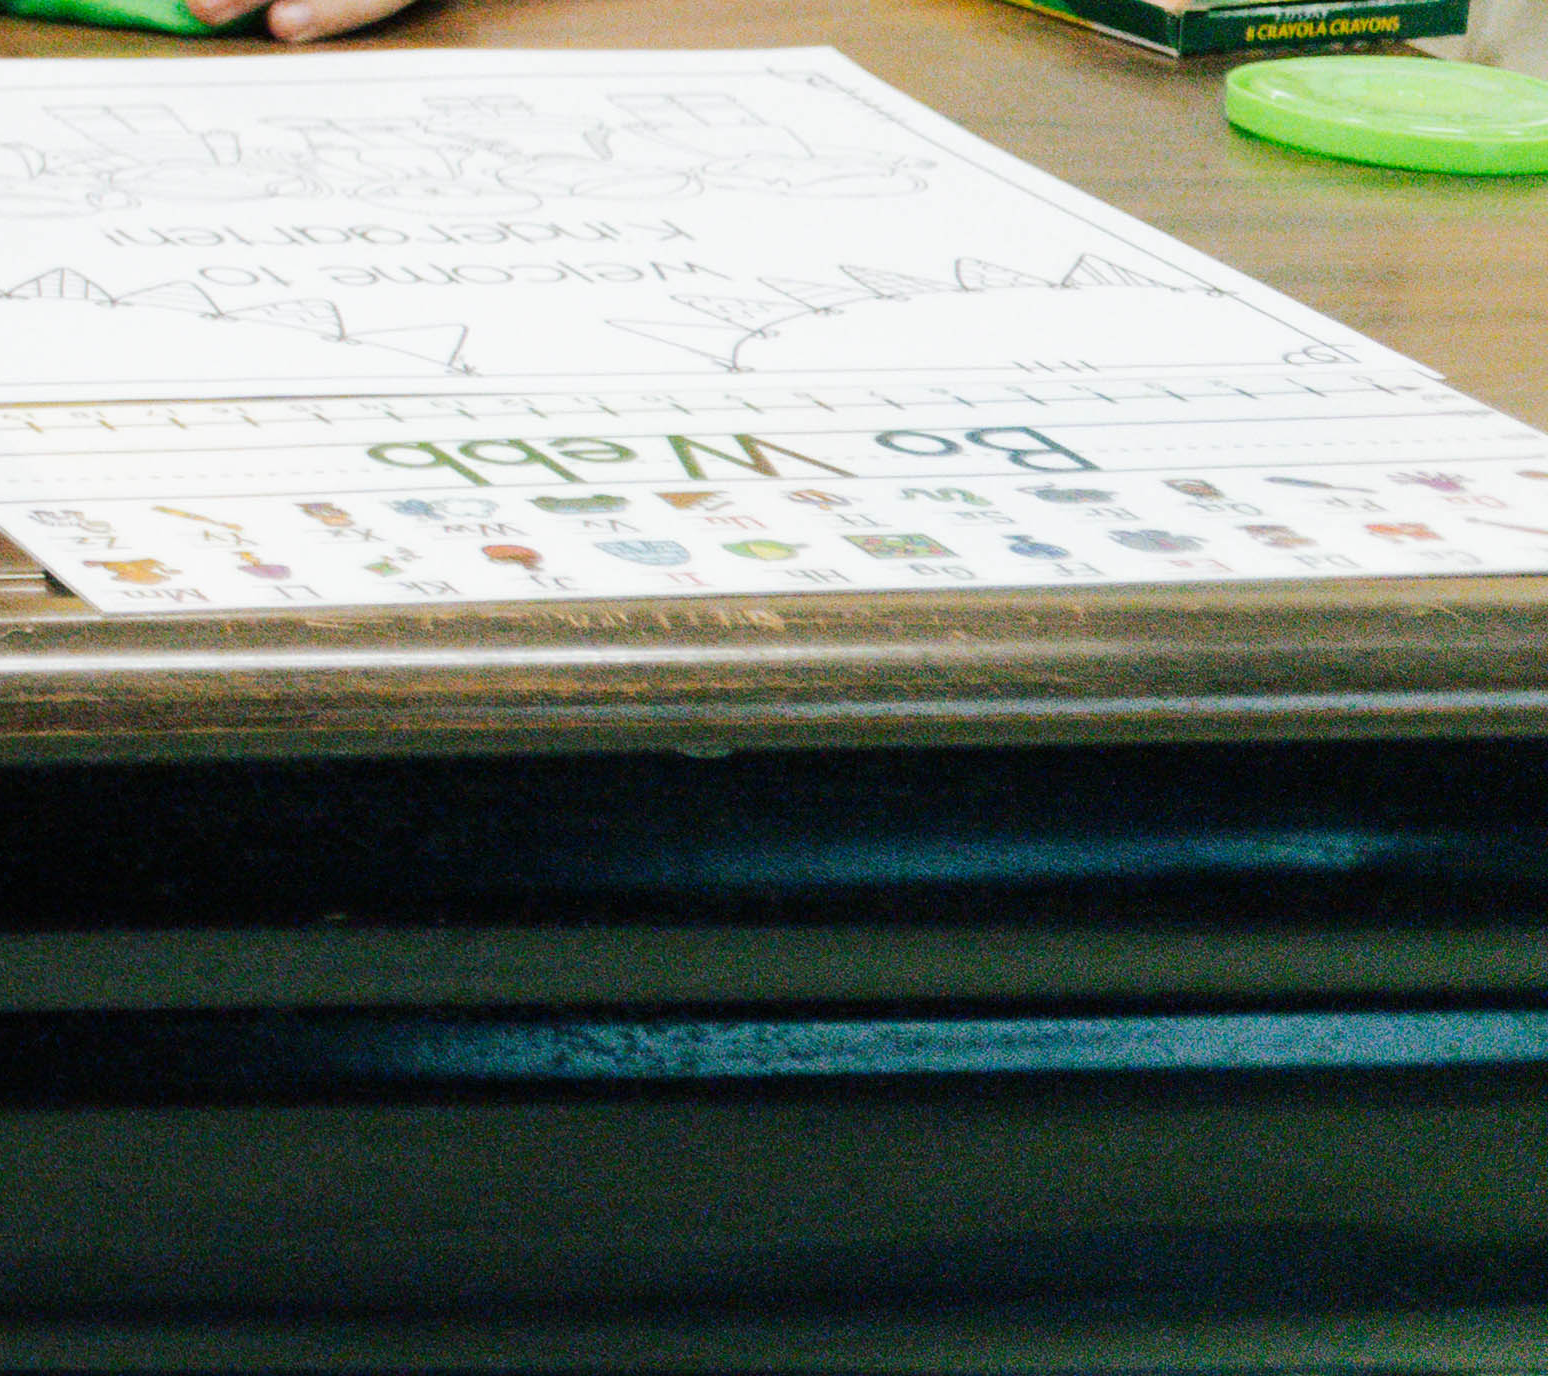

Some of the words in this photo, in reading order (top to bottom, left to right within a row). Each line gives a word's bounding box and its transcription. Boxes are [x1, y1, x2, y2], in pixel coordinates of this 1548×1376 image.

[1257, 21, 1327, 40] CRAYOLA
[1329, 15, 1400, 36] CRAYONS
[366, 433, 857, 488] Webb
[874, 426, 1099, 474] Bo
